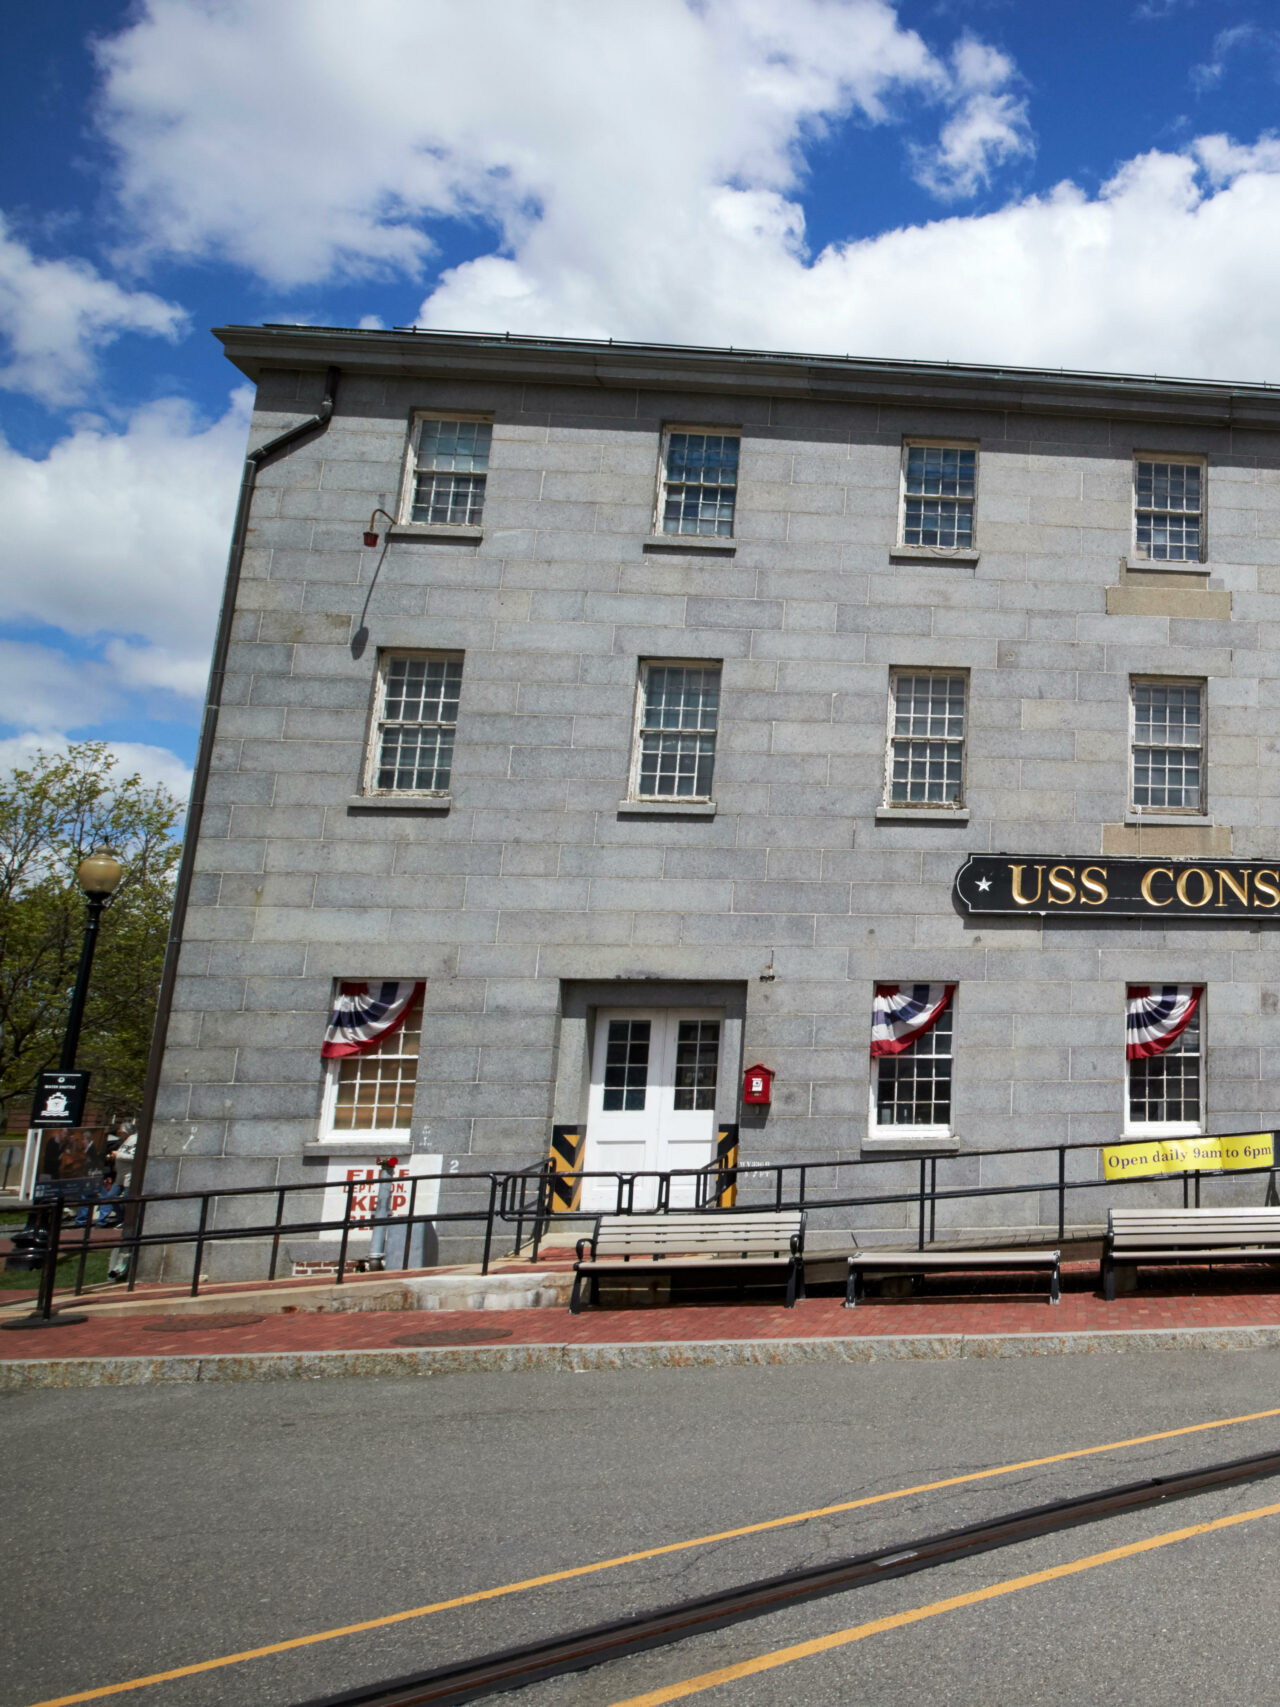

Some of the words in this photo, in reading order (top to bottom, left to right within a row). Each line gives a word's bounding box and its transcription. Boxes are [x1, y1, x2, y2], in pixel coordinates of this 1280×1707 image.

[1007, 864, 1109, 905] USS
[449, 1159, 460, 1173] 2
[1108, 1154, 1148, 1169] Open
[1152, 1149, 1188, 1162] daily
[1193, 1147, 1222, 1159] 9am
[1225, 1147, 1239, 1158] to
[1243, 1145, 1272, 1159] 6pm
[350, 1194, 407, 1211] KEP
